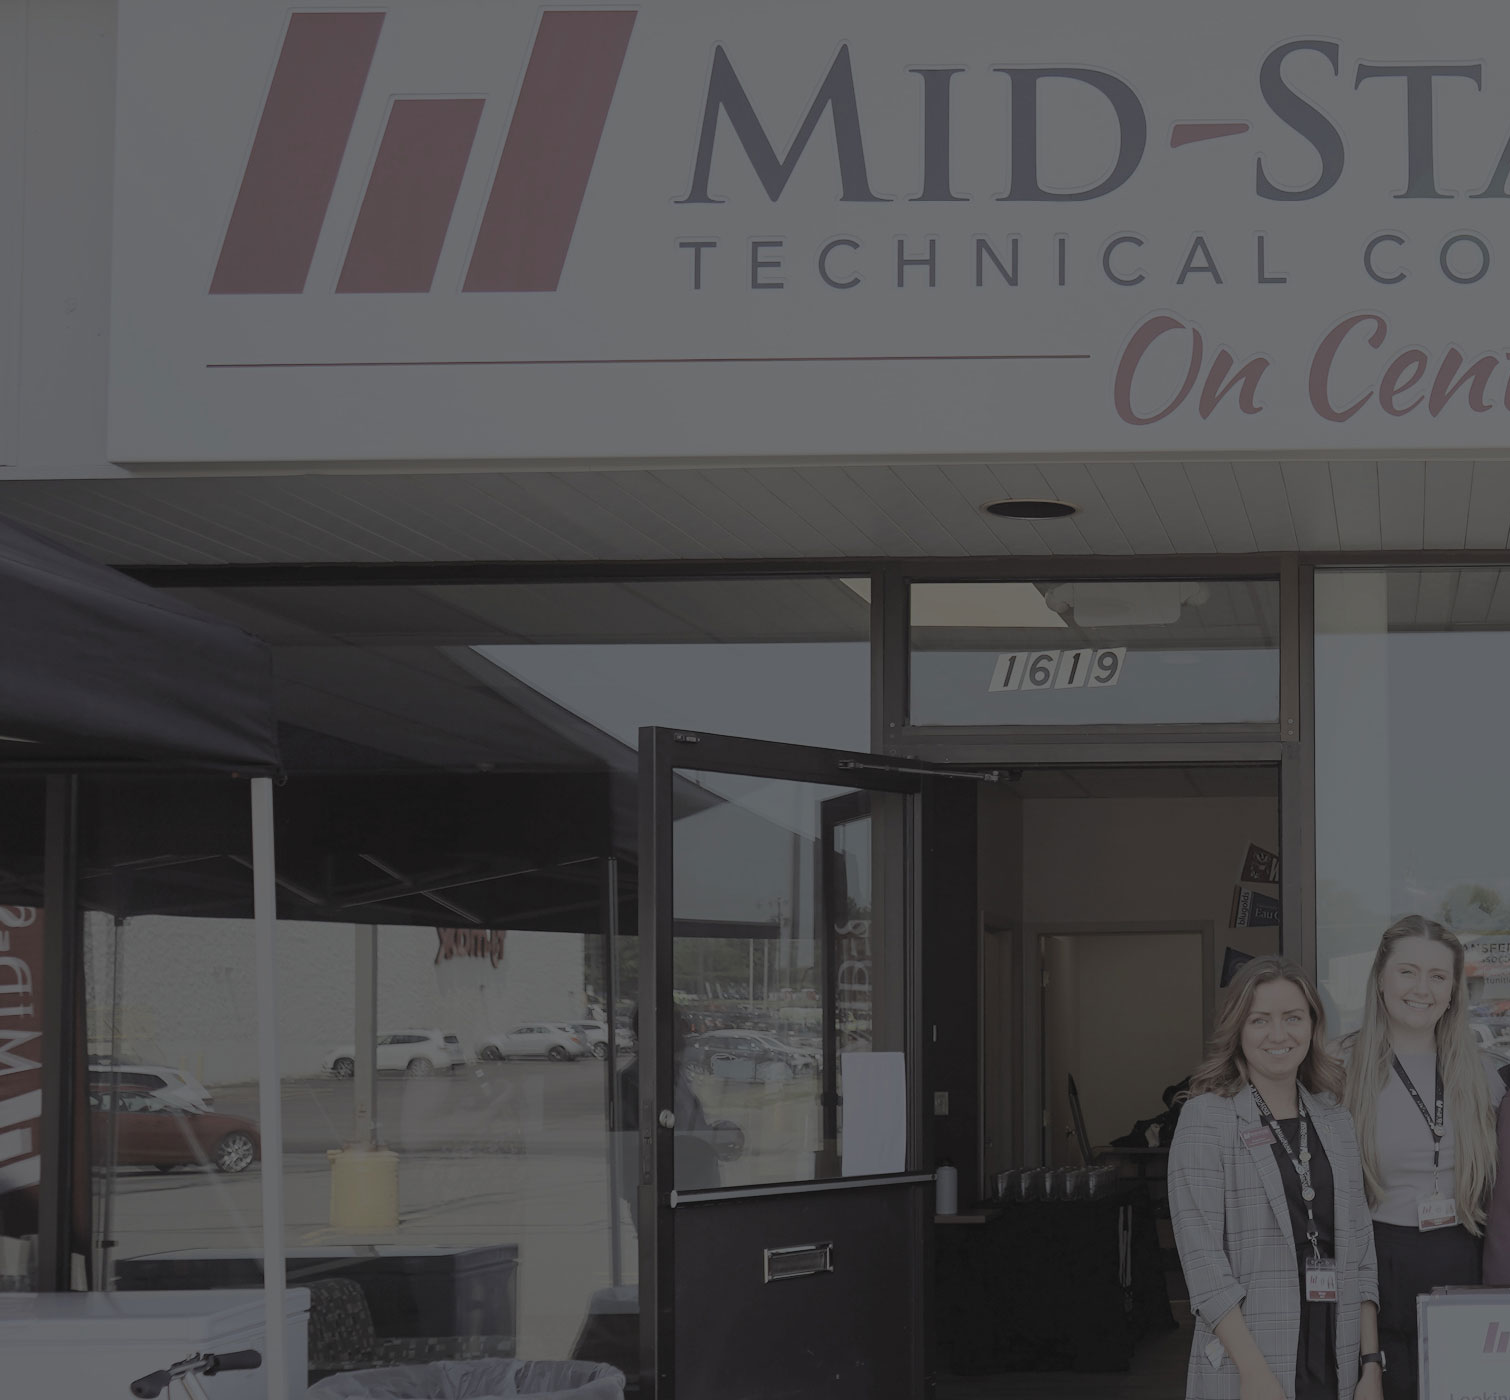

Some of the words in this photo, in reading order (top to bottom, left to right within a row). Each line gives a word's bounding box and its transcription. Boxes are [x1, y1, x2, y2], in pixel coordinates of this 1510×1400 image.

[678, 236, 1288, 290] TECHNICAL
[1113, 315, 1271, 426] On
[1002, 651, 1119, 688] 1619
